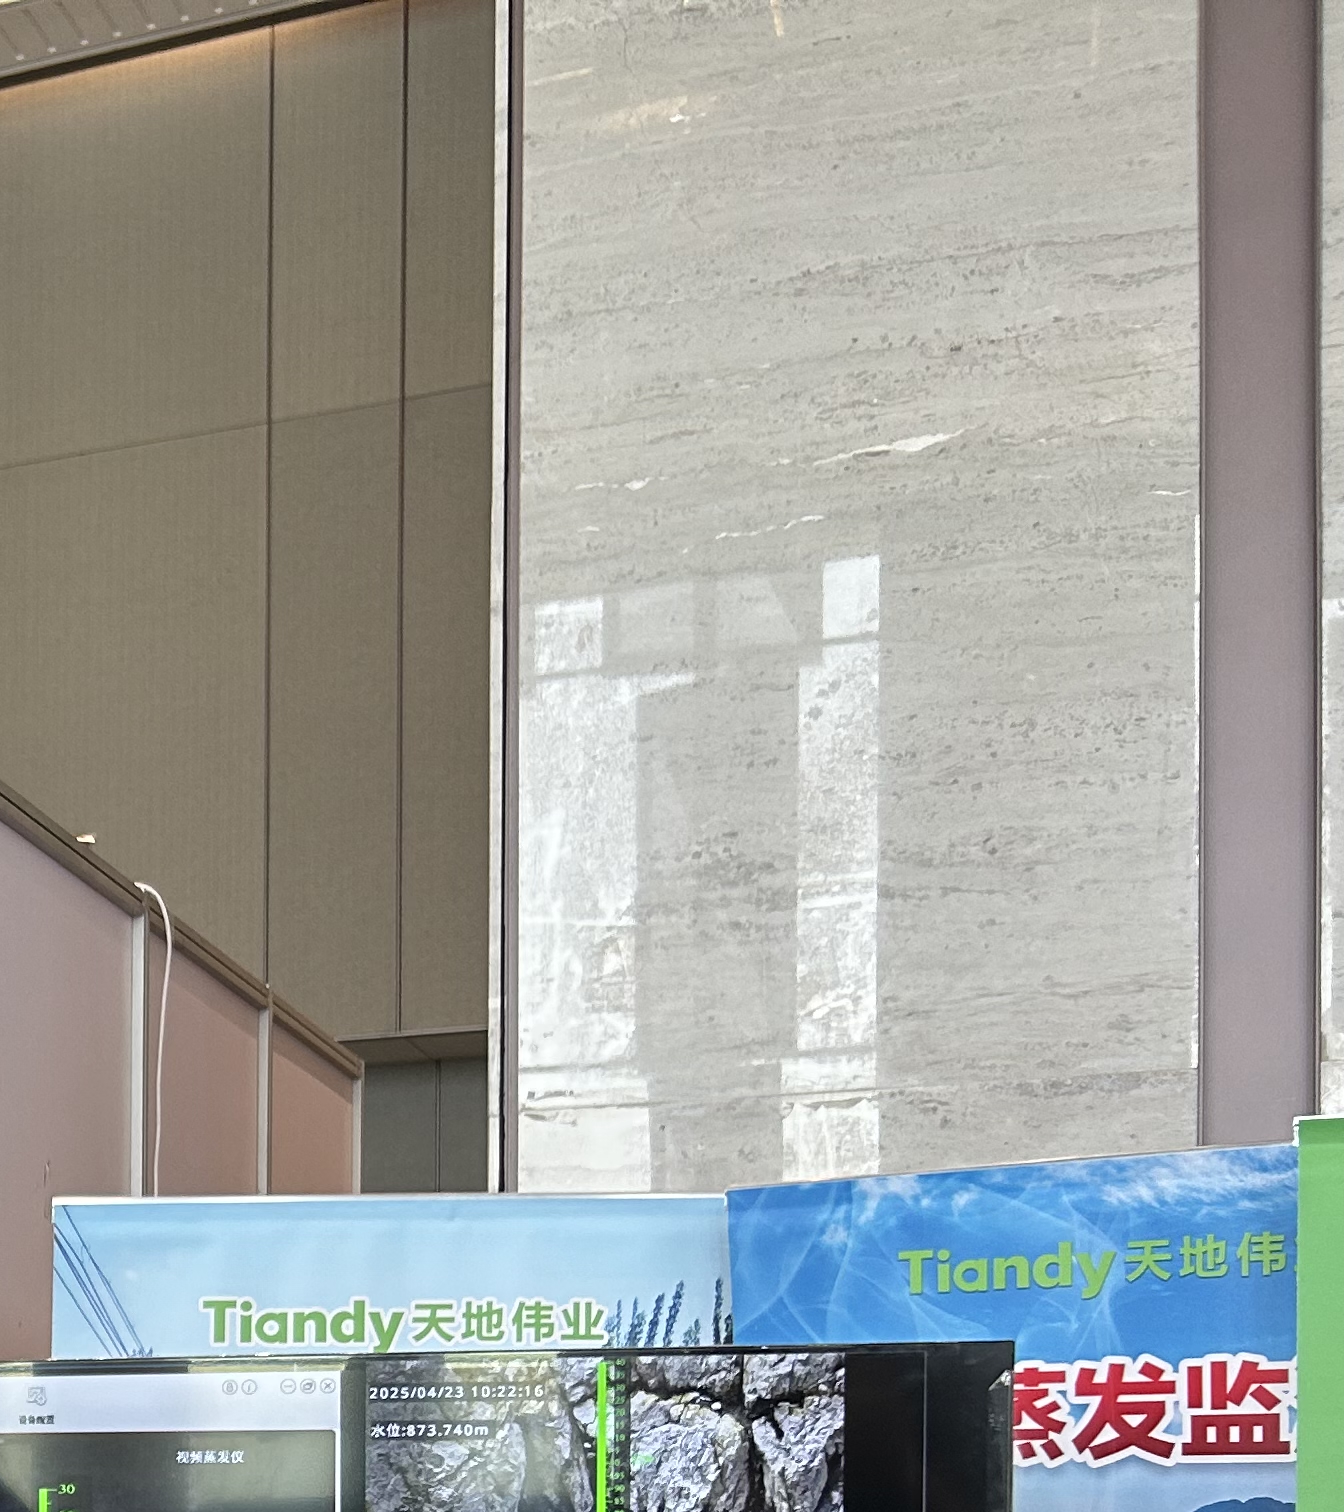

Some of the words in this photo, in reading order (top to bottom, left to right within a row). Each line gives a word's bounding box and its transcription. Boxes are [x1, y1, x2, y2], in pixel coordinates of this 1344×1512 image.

[898, 1241, 1116, 1299] Tiandy
[1125, 1231, 1297, 1282] 天地伟
[202, 1299, 404, 1353] Tiandy
[412, 1299, 606, 1342] 天地伟业
[369, 1385, 464, 1400] 2025/04/23
[471, 1384, 544, 1398] 10:22:16
[1013, 1361, 1297, 1461] 蒸发监
[370, 1423, 489, 1438] 水位:873.740m
[58, 1484, 76, 1494] 30
